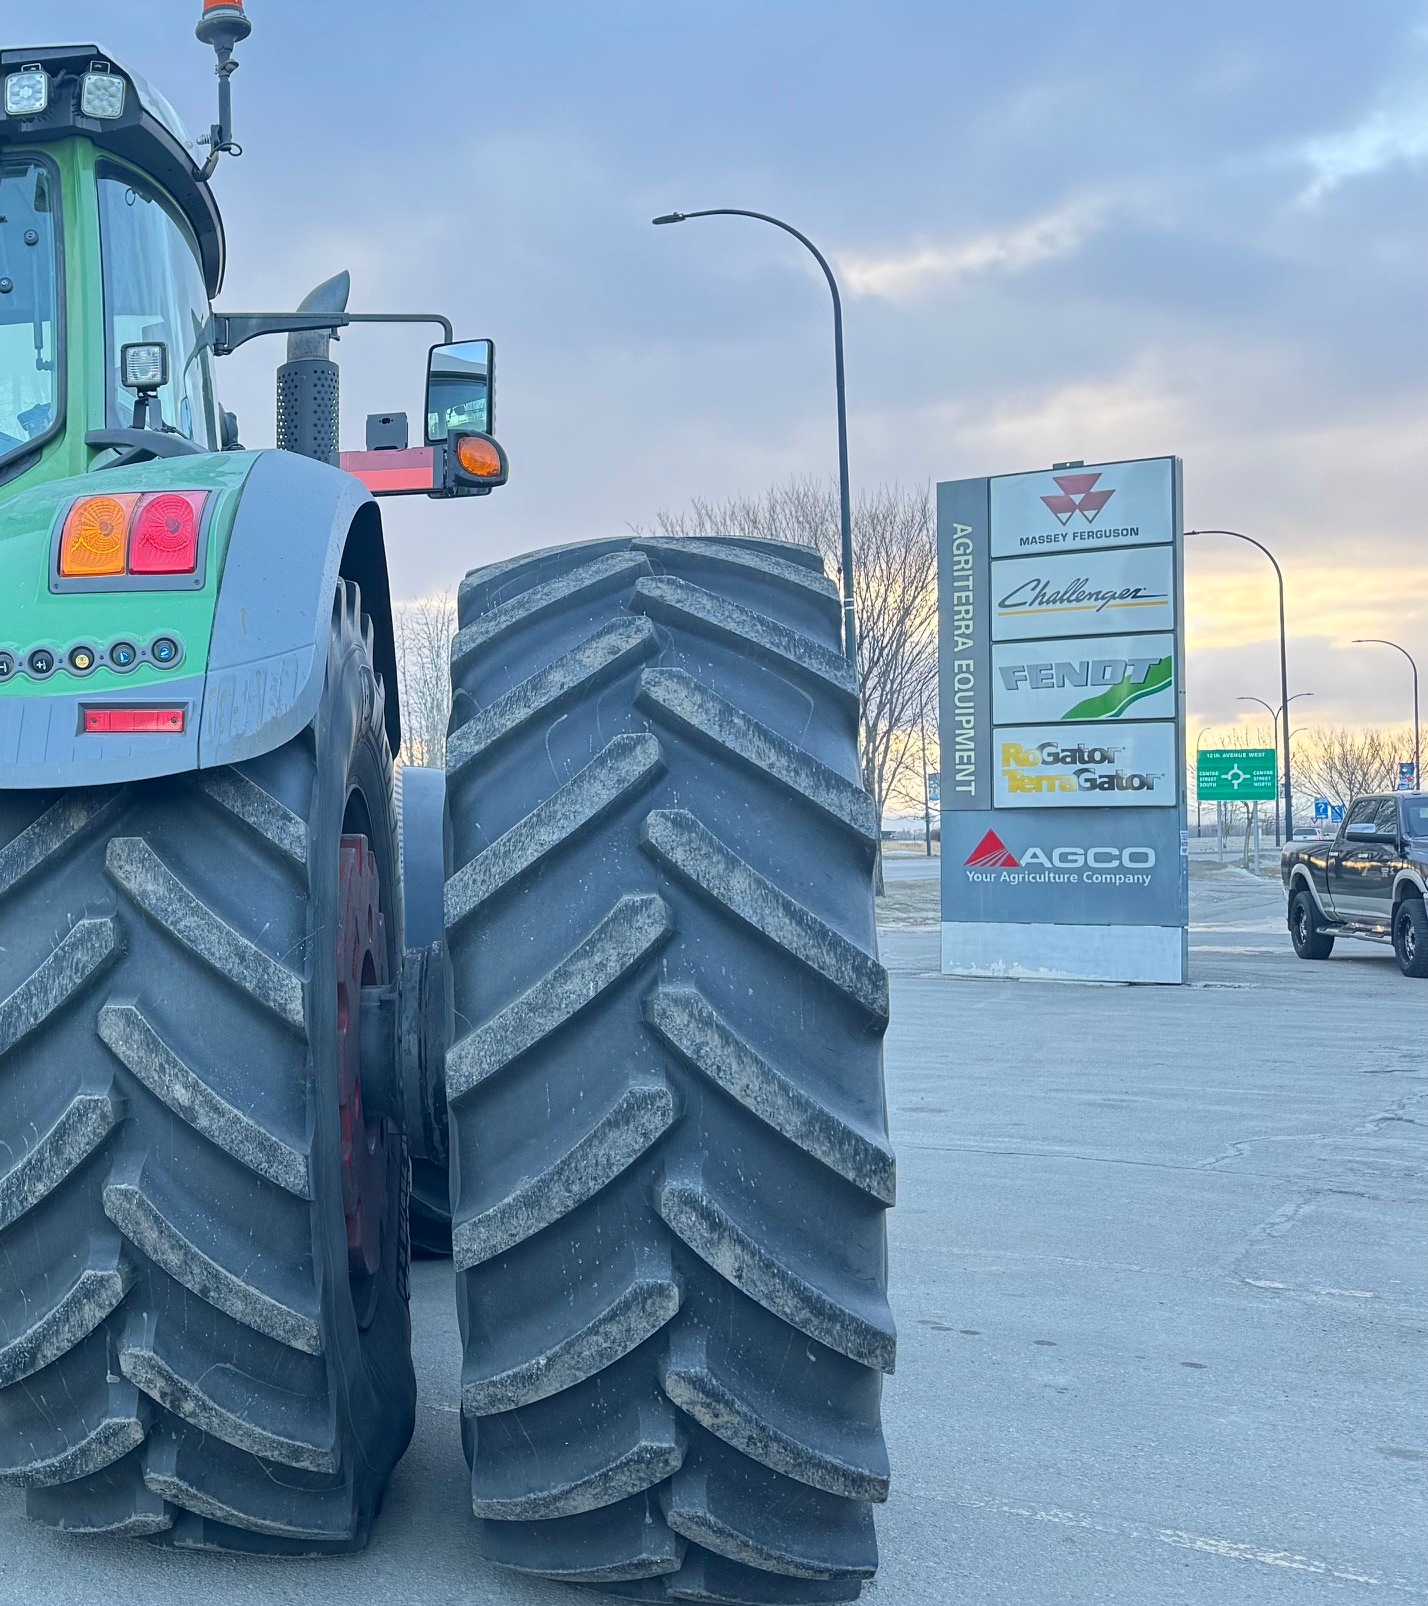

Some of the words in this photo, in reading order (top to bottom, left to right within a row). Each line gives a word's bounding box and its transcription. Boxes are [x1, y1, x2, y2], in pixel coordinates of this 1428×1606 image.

[1019, 532, 1068, 547] MASSEY
[1072, 527, 1139, 541] FERGUSON
[953, 523, 974, 652] AGRITERRA
[998, 577, 1155, 613] Challenger
[999, 657, 1163, 691] FENDT
[954, 659, 976, 796] EQUIPMENT
[1001, 741, 1123, 767] RoGator
[1002, 767, 1161, 794] TerraGator
[1020, 847, 1156, 868] AGCO
[966, 870, 996, 883] Your
[1000, 870, 1078, 884] Agriculture
[1083, 871, 1152, 886] Company
